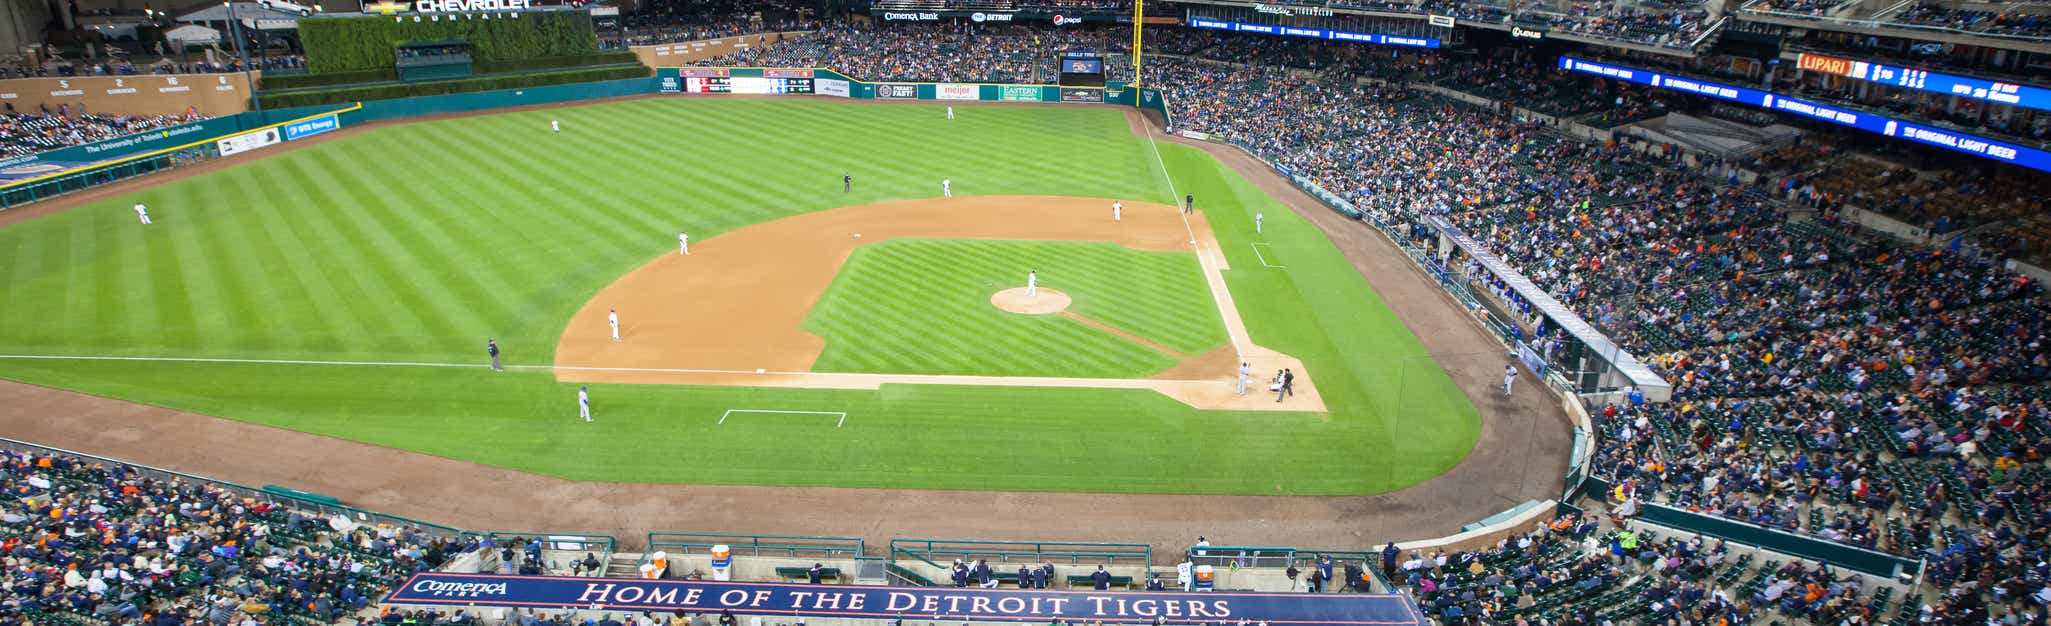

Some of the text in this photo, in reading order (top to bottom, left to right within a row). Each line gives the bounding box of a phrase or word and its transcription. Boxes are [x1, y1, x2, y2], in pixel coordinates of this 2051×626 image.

[416, 0, 531, 13] CHEVROLET
[395, 12, 519, 23] FOUNTAIN
[919, 12, 938, 20] Bank
[1064, 16, 1082, 24] pepsi
[1804, 56, 1846, 73] LIPARI
[944, 85, 970, 96] meijer
[1003, 86, 1038, 96] EASTERN
[85, 145, 100, 153] The
[100, 139, 133, 152] University
[1915, 128, 1958, 147] ORIGINAL
[1957, 138, 1989, 153] LIGHT
[1987, 144, 2017, 160] BEER
[577, 583, 1232, 618] HOME OF THE DETROIT TIGERS
